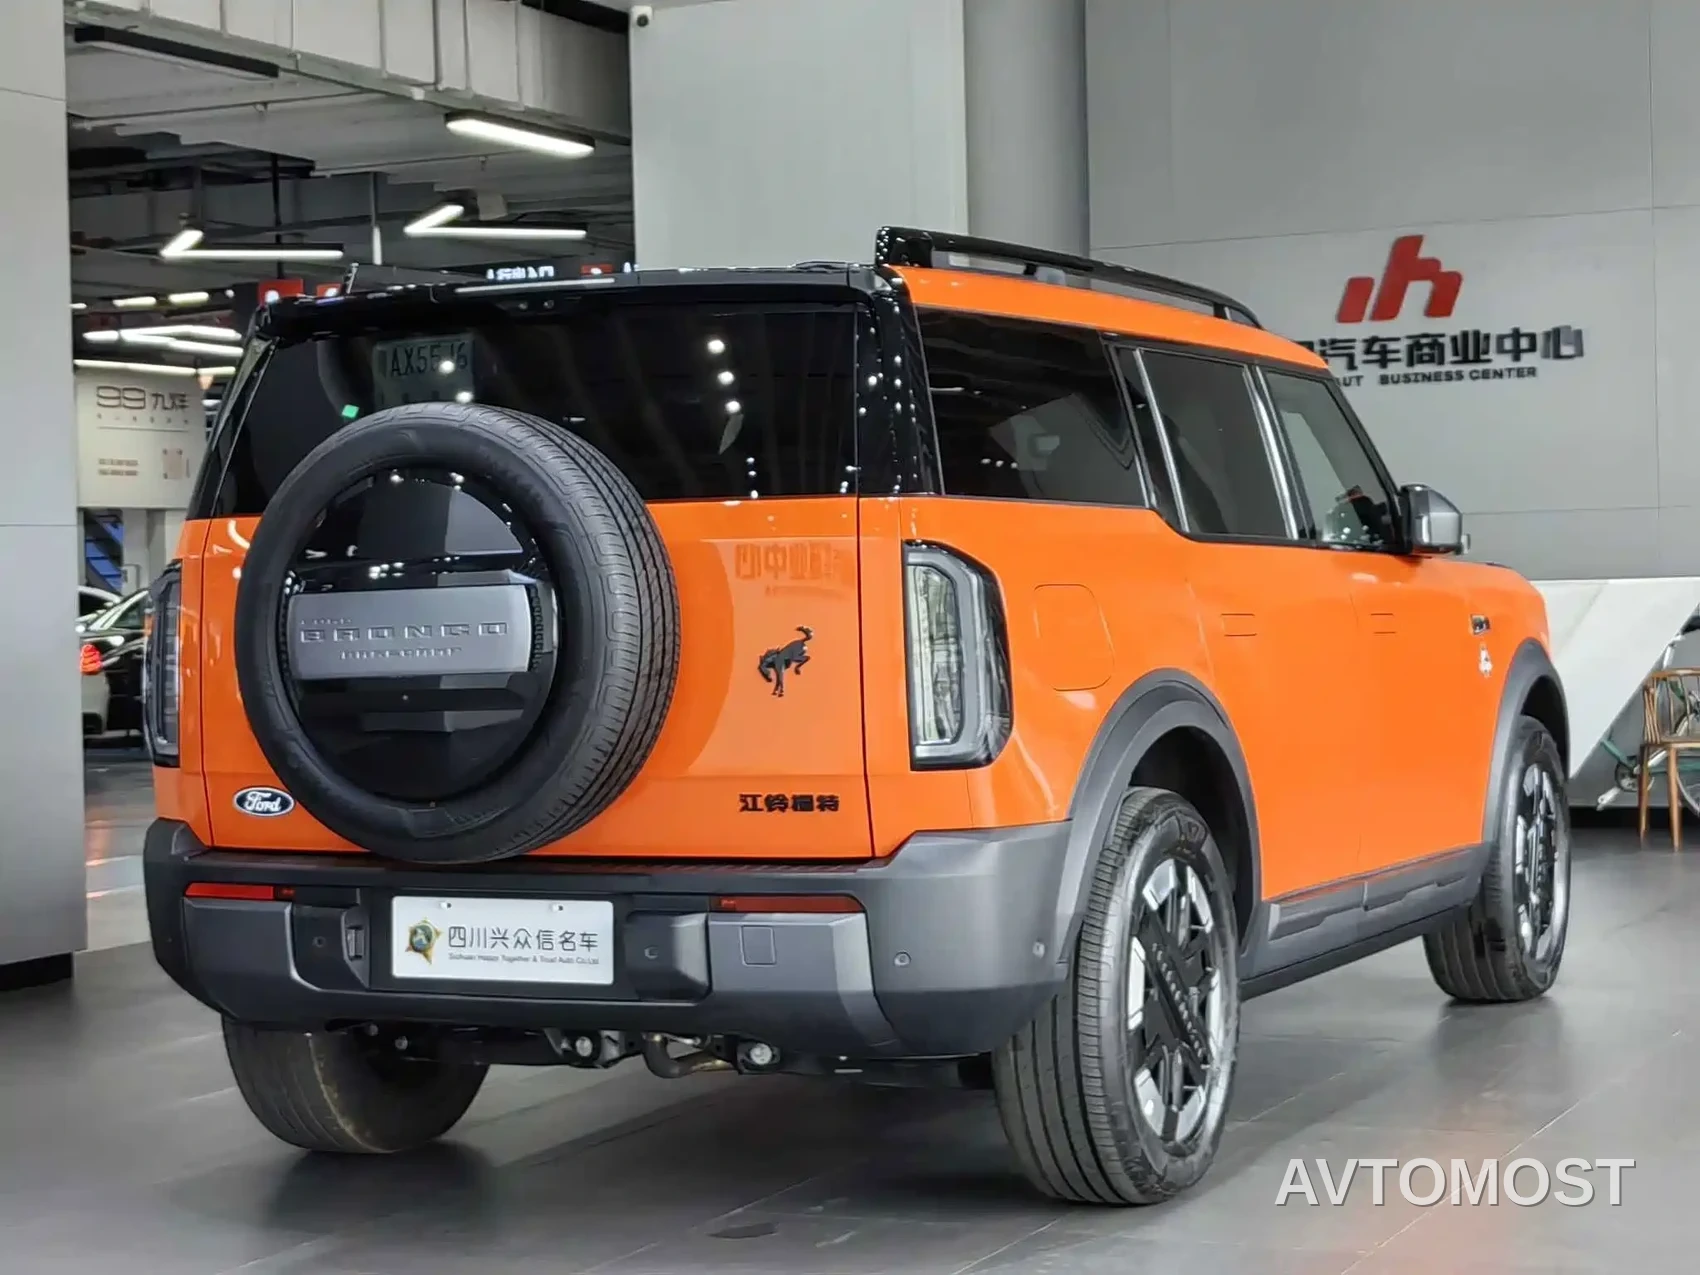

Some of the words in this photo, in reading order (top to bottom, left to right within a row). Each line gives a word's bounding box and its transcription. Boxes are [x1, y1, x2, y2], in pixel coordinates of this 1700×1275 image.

[1298, 326, 1584, 371] 汽车商业中心
[1379, 370, 1465, 385] BUSINESS
[1469, 366, 1537, 380] CENTER
[300, 622, 508, 643] BRONCO
[244, 791, 282, 812] Ford
[448, 926, 598, 951] 四川兴众信名车
